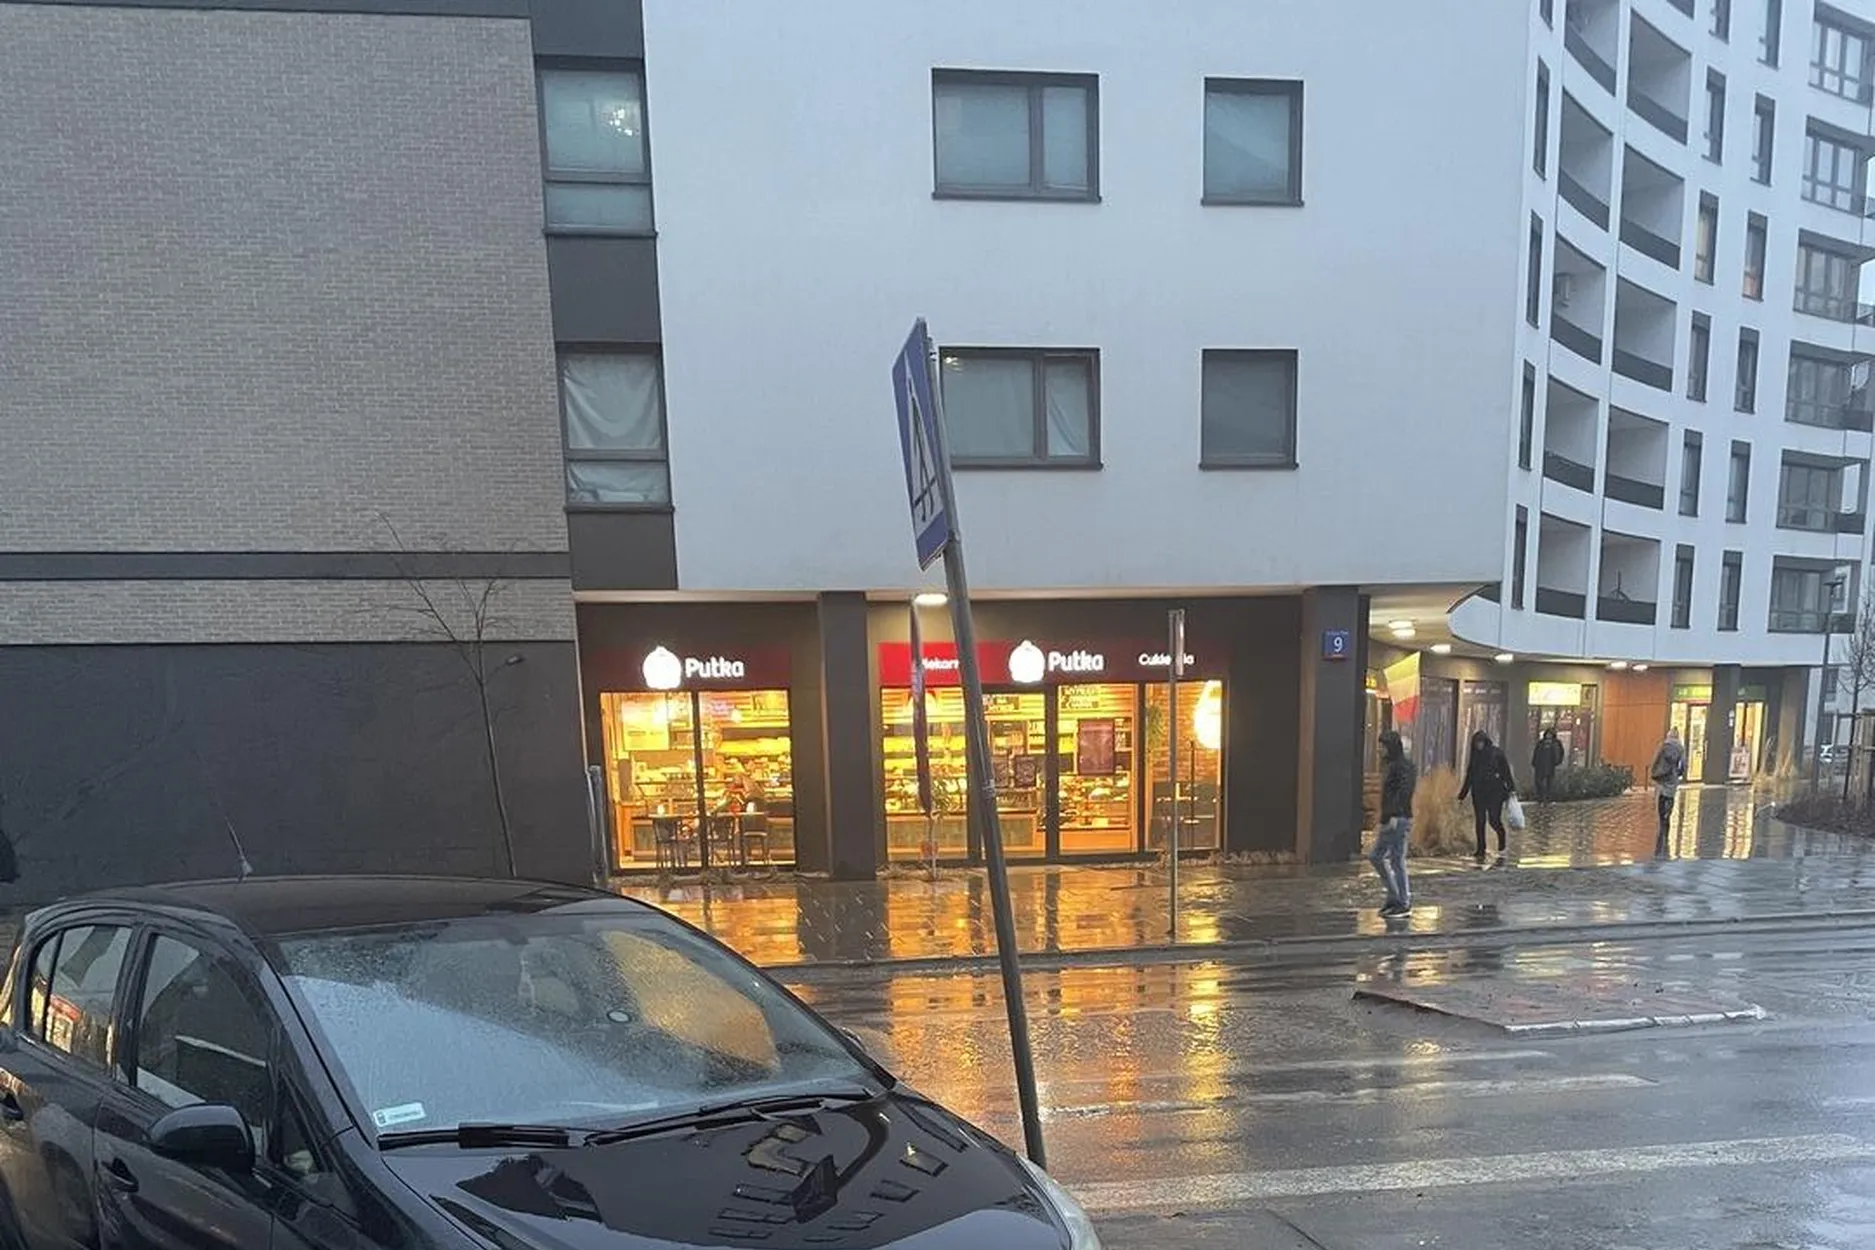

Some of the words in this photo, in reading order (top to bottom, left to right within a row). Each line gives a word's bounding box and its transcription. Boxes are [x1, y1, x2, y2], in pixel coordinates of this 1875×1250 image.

[1333, 636, 1343, 653] 9
[684, 655, 745, 678] Putka
[1048, 650, 1104, 671] Putka
[1138, 653, 1194, 666] Cukieia
